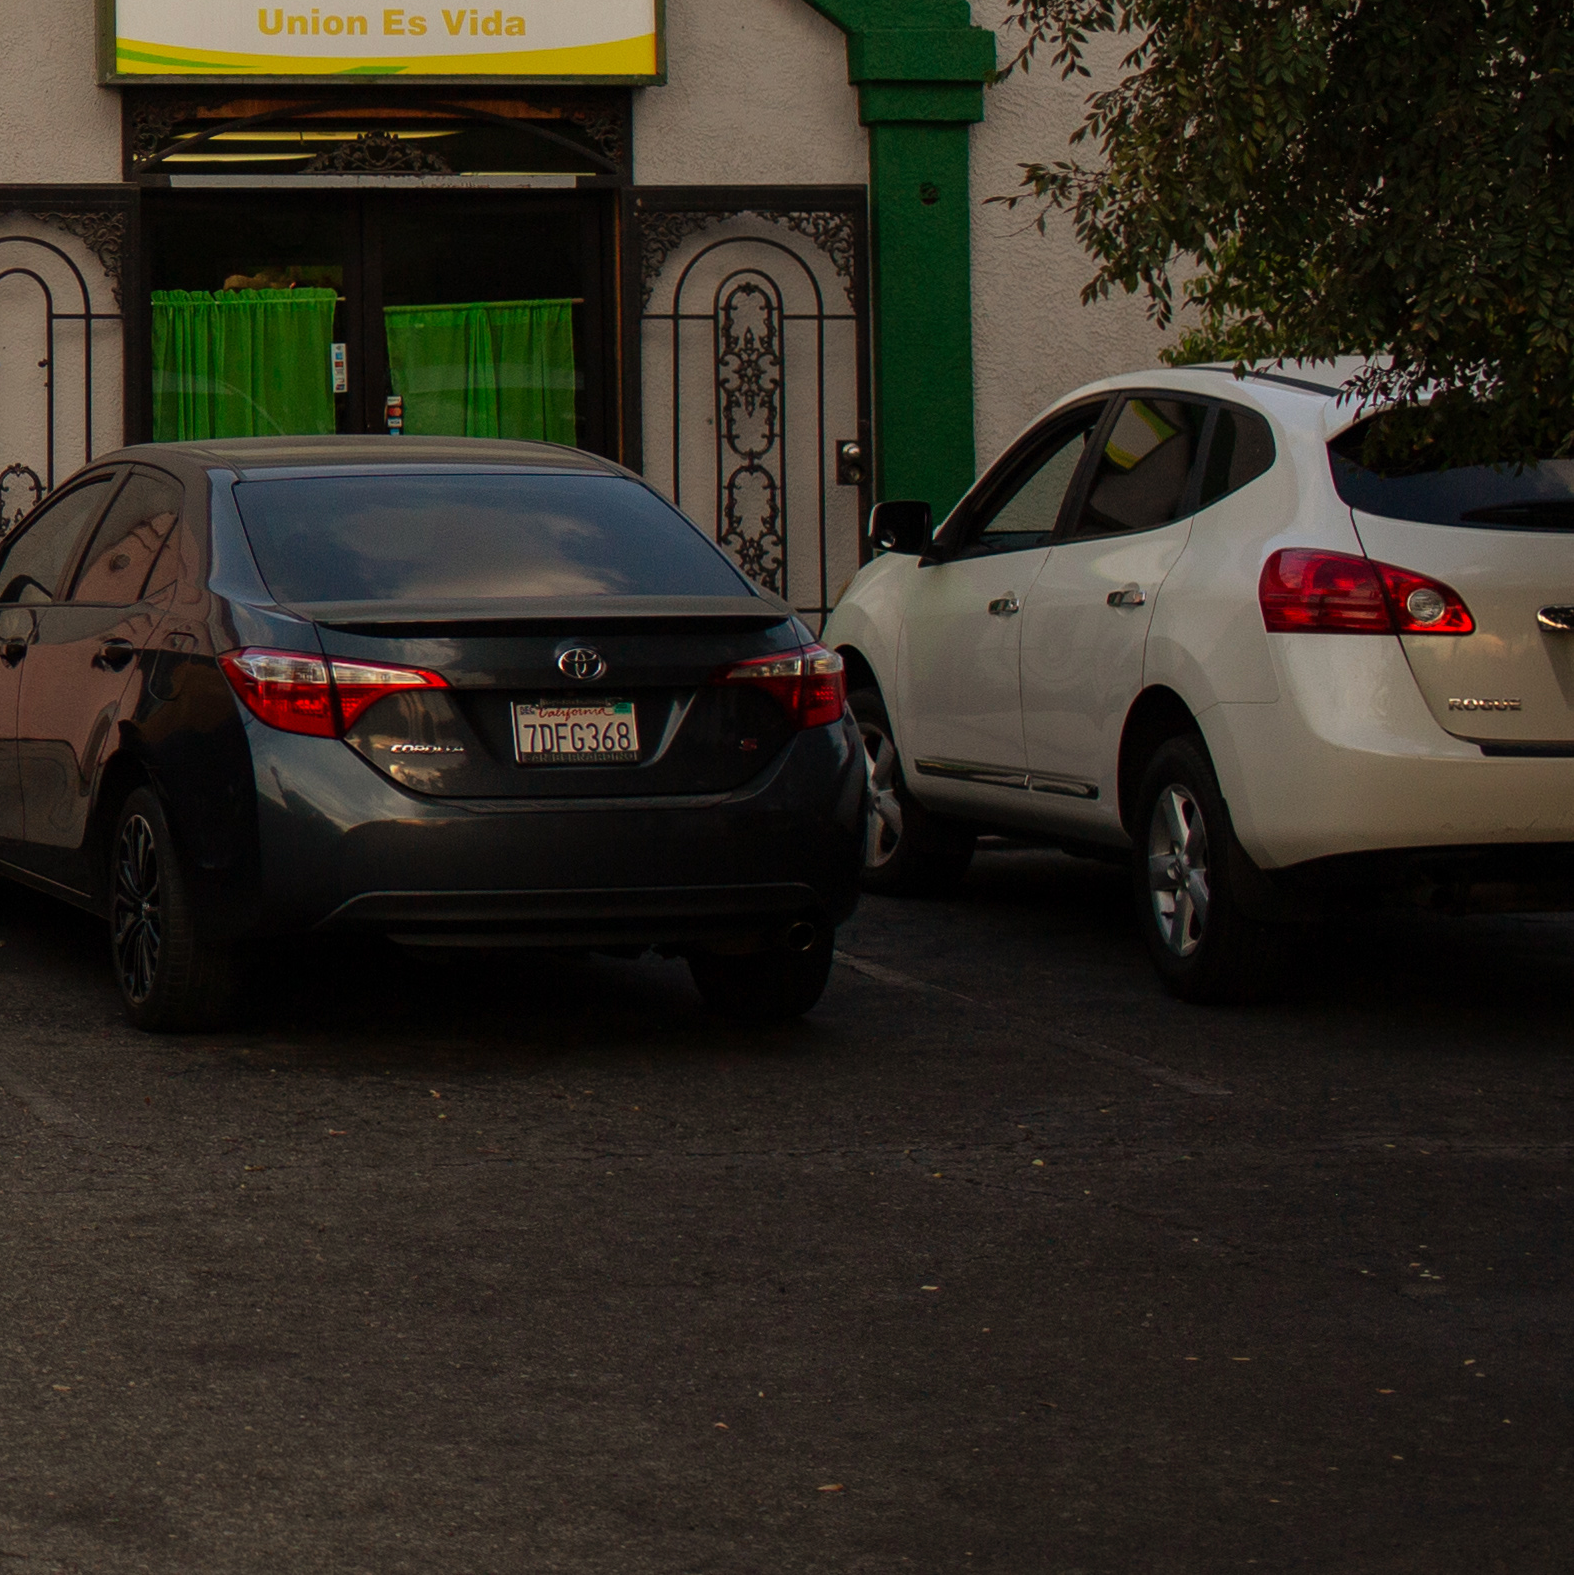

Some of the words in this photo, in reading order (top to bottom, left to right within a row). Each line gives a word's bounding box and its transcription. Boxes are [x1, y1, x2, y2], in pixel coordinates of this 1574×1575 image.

[258, 8, 368, 36] Union
[383, 9, 428, 36] Es
[442, 10, 526, 36] Vida
[538, 707, 614, 721] California
[1448, 698, 1522, 711] ROGUE
[523, 722, 631, 752] 7DFG368
